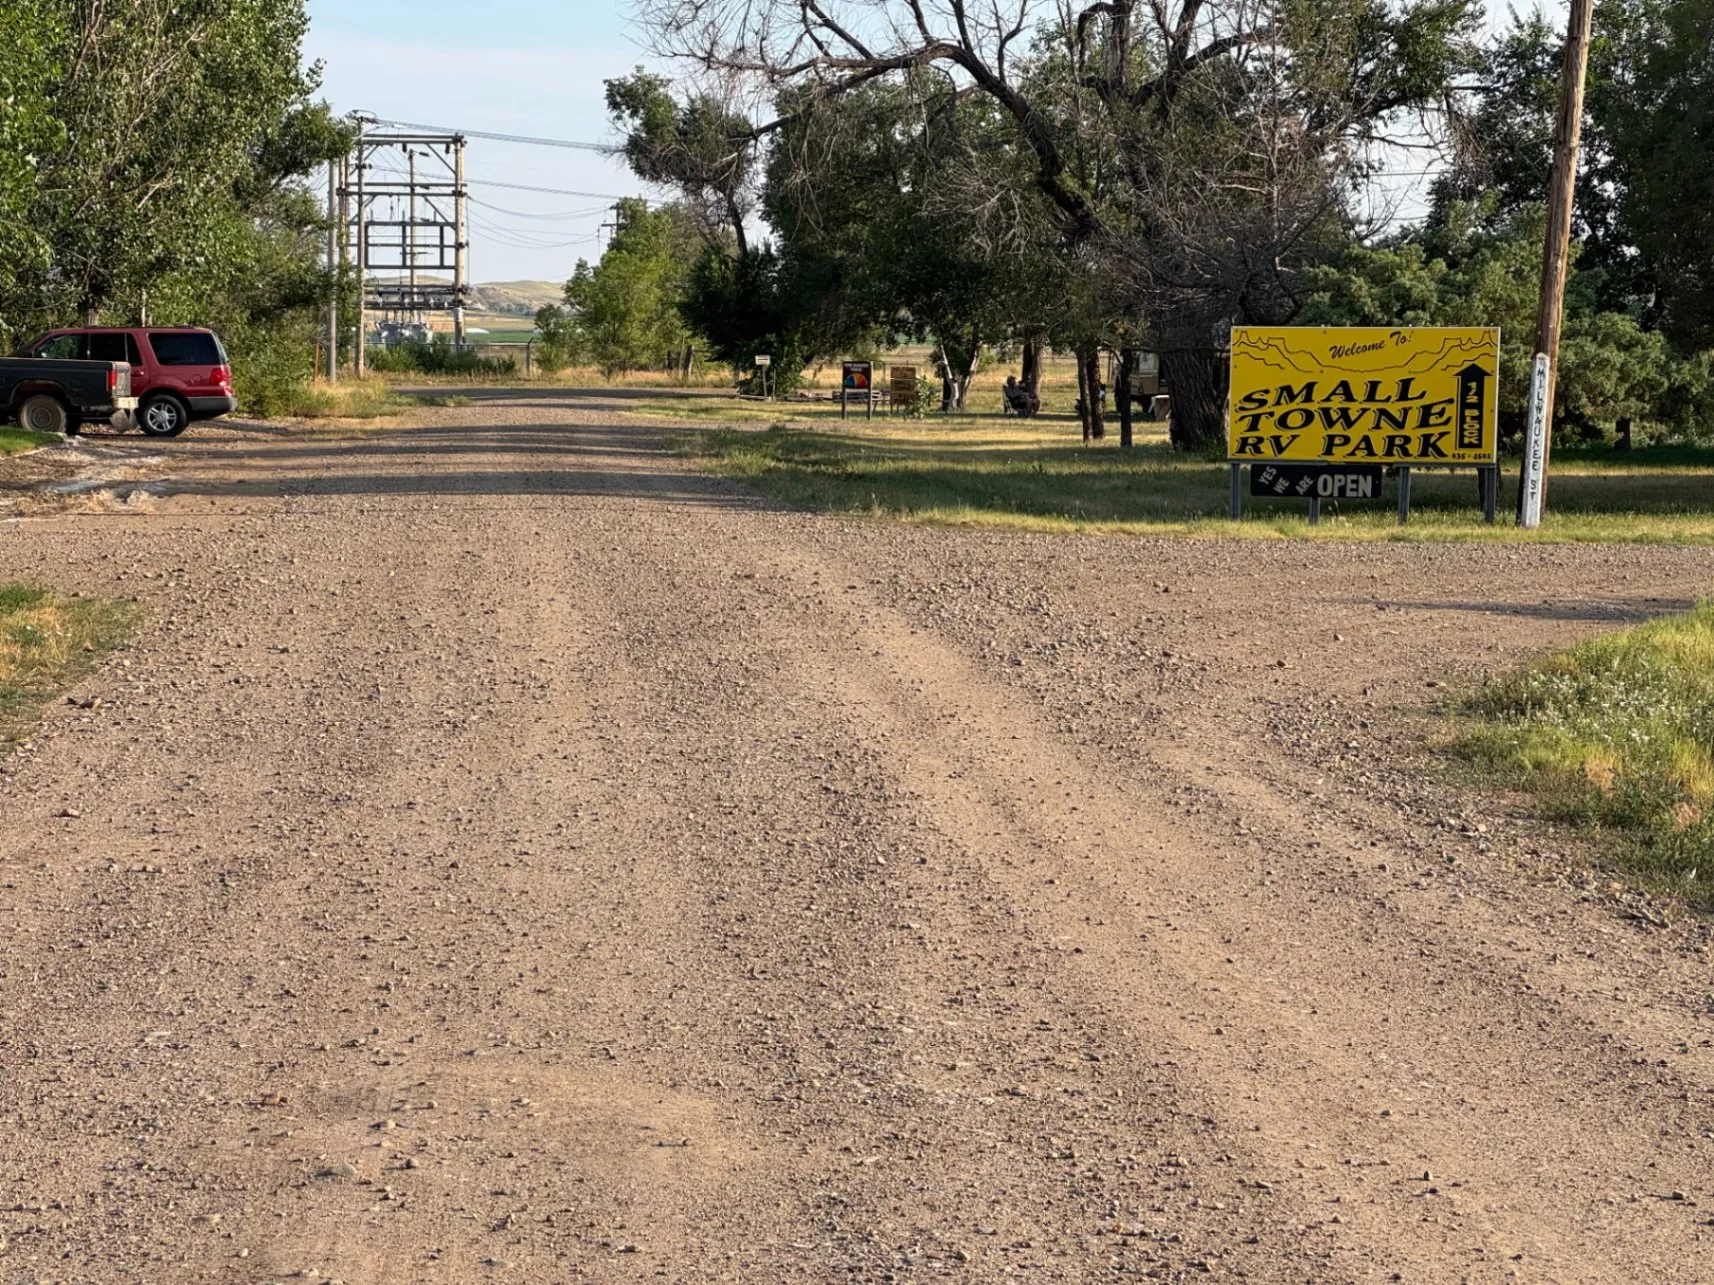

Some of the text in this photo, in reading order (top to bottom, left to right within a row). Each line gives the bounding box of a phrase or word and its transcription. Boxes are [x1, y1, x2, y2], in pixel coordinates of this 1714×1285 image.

[1329, 330, 1412, 359] Welcome To:
[1234, 377, 1427, 413] SMALL
[1235, 398, 1455, 434] TOWNE
[1463, 409, 1480, 444] BLOCK
[1232, 431, 1452, 459] RV PARK
[1530, 368, 1545, 500] MILWAUKEE ST
[1259, 466, 1372, 497] YES WE ARE OPEN
